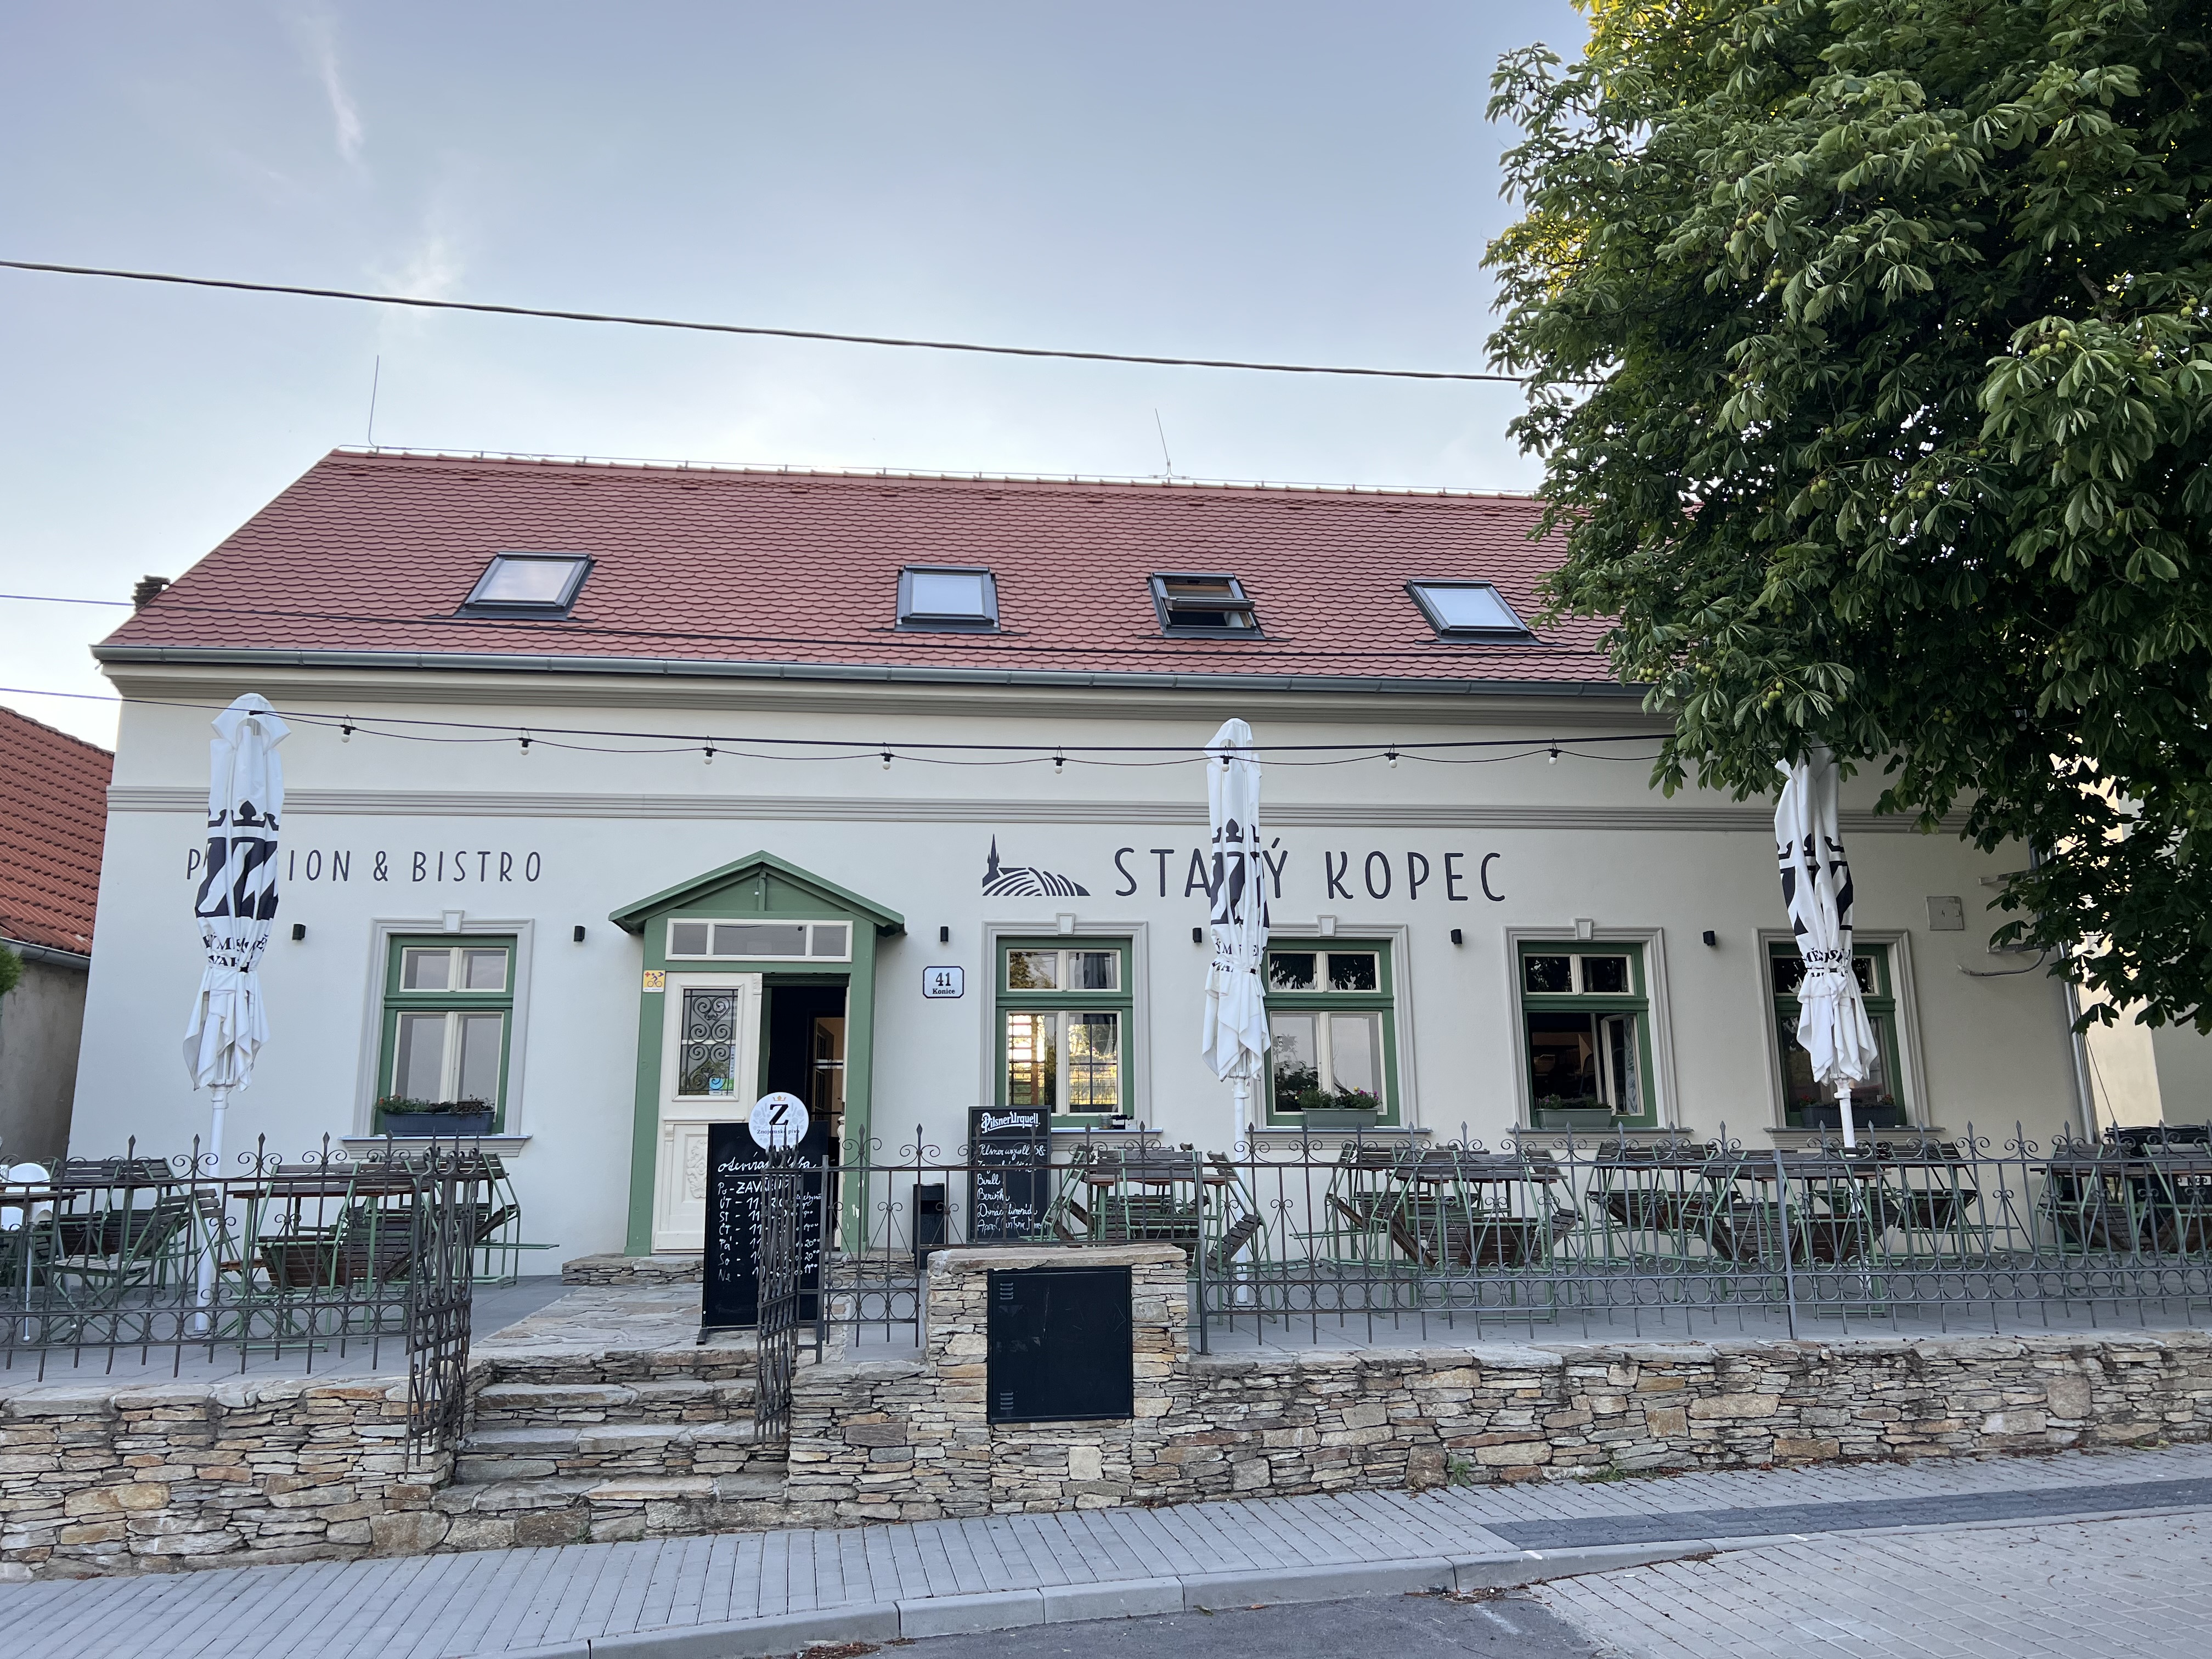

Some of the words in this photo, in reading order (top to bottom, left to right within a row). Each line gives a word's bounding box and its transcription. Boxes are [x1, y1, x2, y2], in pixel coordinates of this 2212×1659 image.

[187, 849, 351, 882] PION
[373, 851, 388, 881] &
[413, 851, 541, 882] BISTRO
[1114, 837, 1288, 899] STAÝ
[1325, 851, 1505, 901] KOPEC
[935, 972, 951, 986] 41
[769, 1104, 789, 1125] Z
[981, 1112, 1011, 1133] Pilsner
[1009, 1111, 1039, 1128] Urquell
